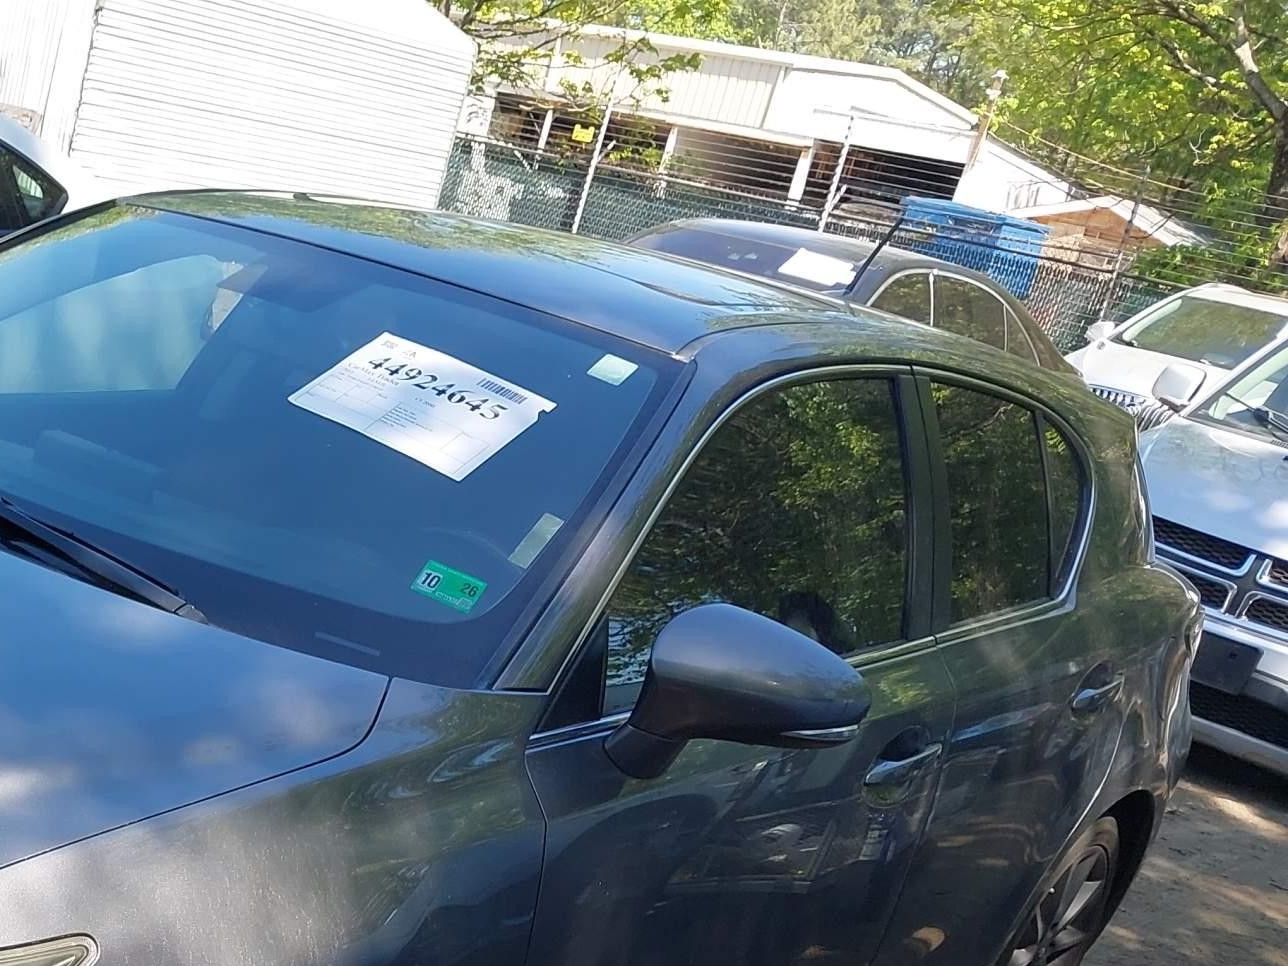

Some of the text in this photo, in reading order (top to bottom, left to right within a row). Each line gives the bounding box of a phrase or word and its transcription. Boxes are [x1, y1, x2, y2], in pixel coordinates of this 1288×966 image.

[368, 356, 510, 421] 44924645
[420, 572, 441, 589] 10
[460, 582, 480, 597] 26
